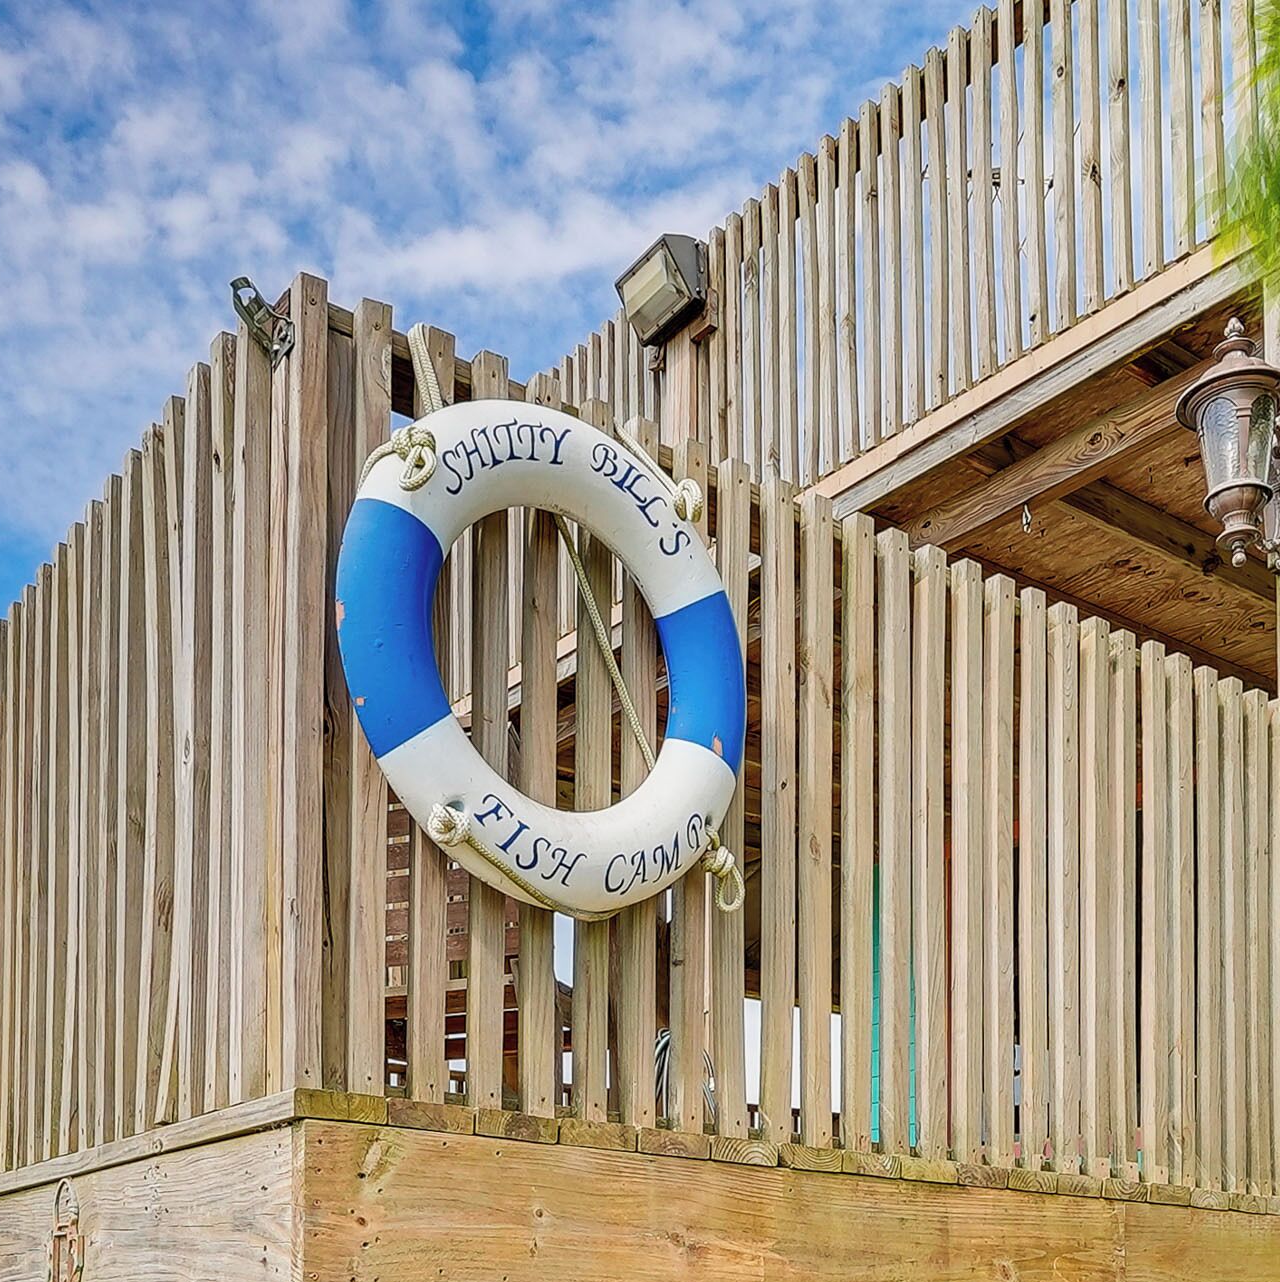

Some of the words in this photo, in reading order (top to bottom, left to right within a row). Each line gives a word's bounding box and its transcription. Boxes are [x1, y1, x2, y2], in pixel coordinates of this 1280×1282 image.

[441, 417, 572, 496] SHITTY
[590, 443, 691, 555] BILL'S
[472, 793, 587, 887] FISH
[604, 813, 703, 894] CAMP
